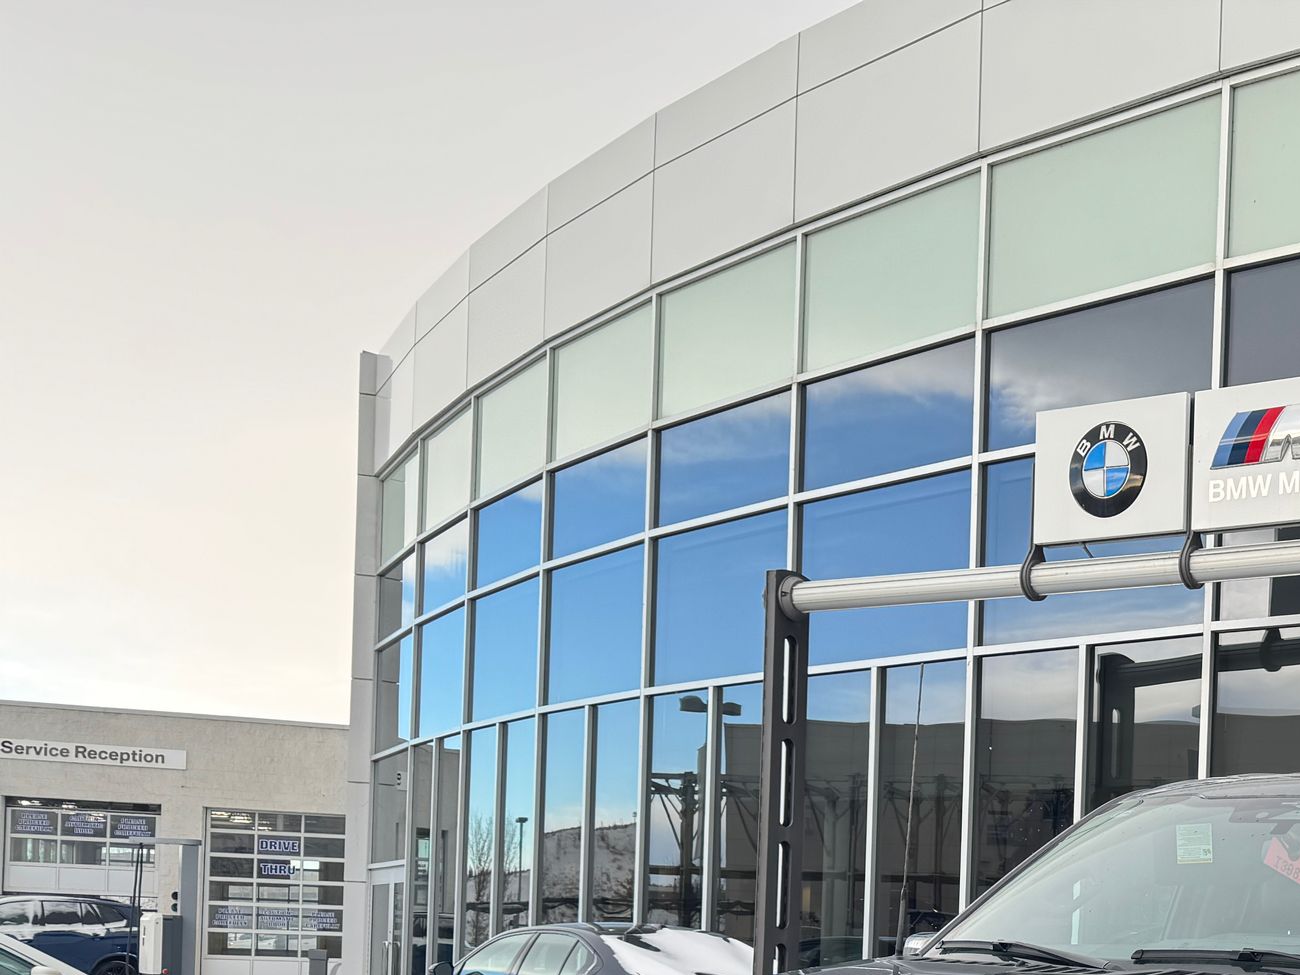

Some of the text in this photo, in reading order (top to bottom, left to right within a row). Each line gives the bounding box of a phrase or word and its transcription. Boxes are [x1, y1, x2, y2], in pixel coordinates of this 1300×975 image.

[1077, 423, 1141, 458] BMW
[1208, 470, 1300, 503] BMW M
[0, 740, 166, 764] Service Reception
[260, 839, 299, 852] DRIVE
[260, 863, 296, 875] THRU
